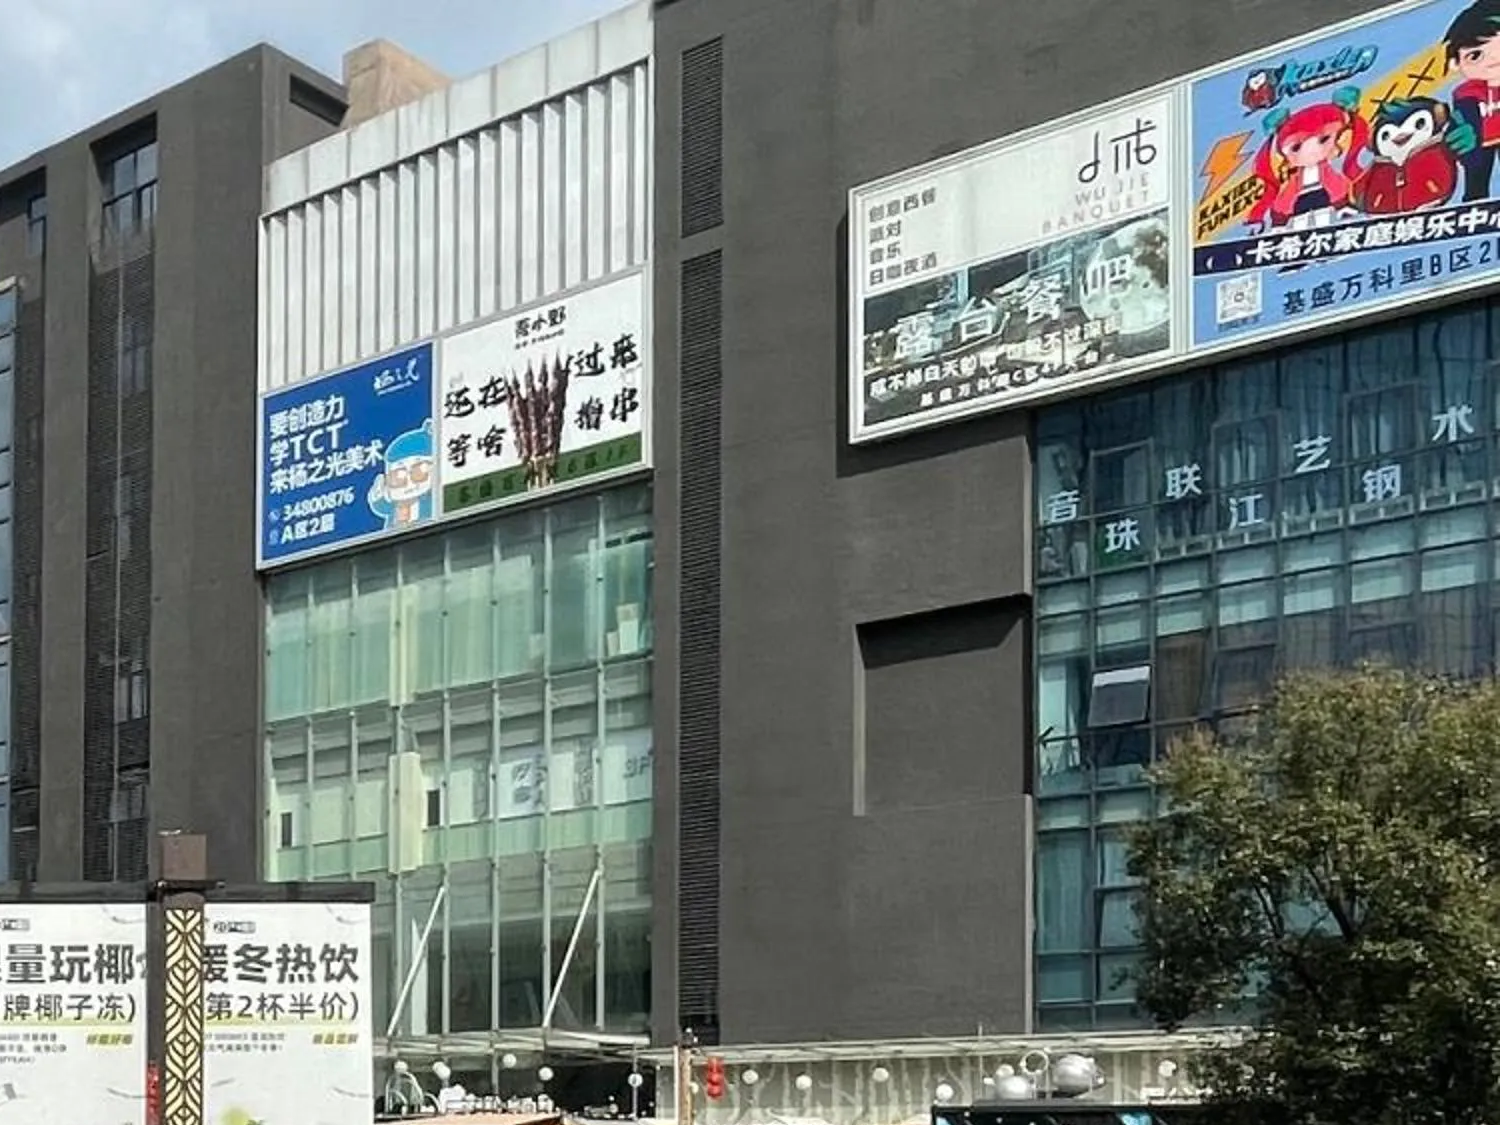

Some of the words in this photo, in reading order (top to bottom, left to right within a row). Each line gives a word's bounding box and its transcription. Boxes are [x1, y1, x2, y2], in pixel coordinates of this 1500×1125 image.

[1283, 238, 1500, 315] 基盛万科里B区2
